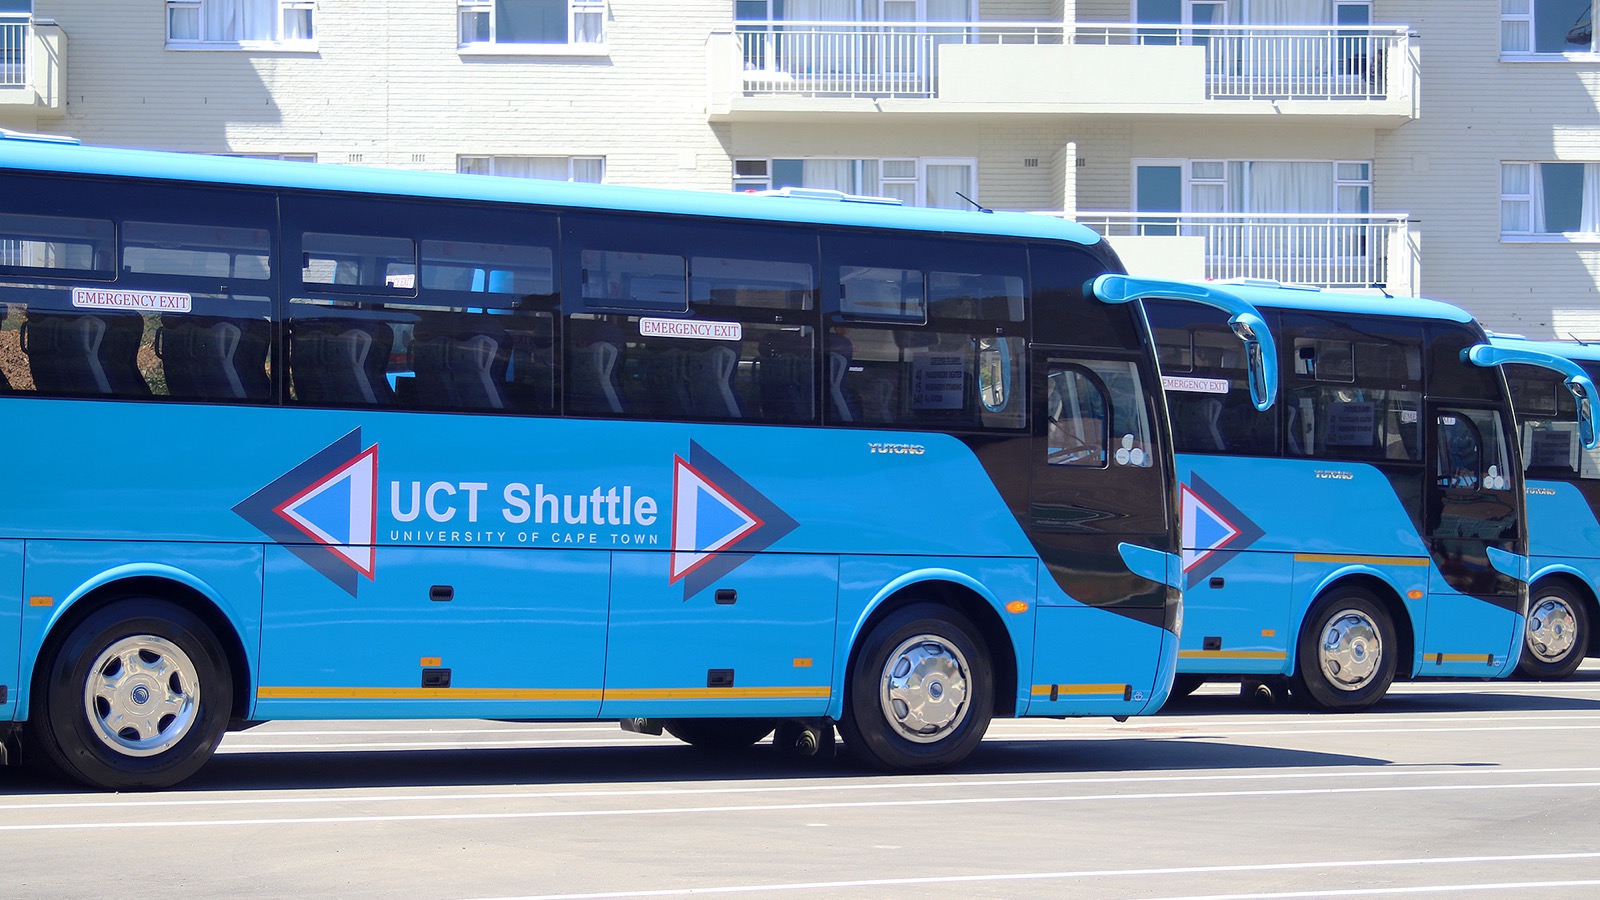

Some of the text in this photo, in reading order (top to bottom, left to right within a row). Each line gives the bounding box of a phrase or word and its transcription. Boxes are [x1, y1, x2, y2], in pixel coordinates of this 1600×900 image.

[77, 291, 189, 309] EMERGENCY EXIT
[644, 321, 739, 337] EMERGENCY EXIT
[1163, 379, 1227, 391] EMERGENCY EXIT
[867, 442, 925, 454] YUTONG
[1313, 469, 1354, 480] YUTONG
[390, 480, 658, 526] UCT Shuttle
[390, 530, 658, 545] UNIVERSITY OF CAPE TOWN
